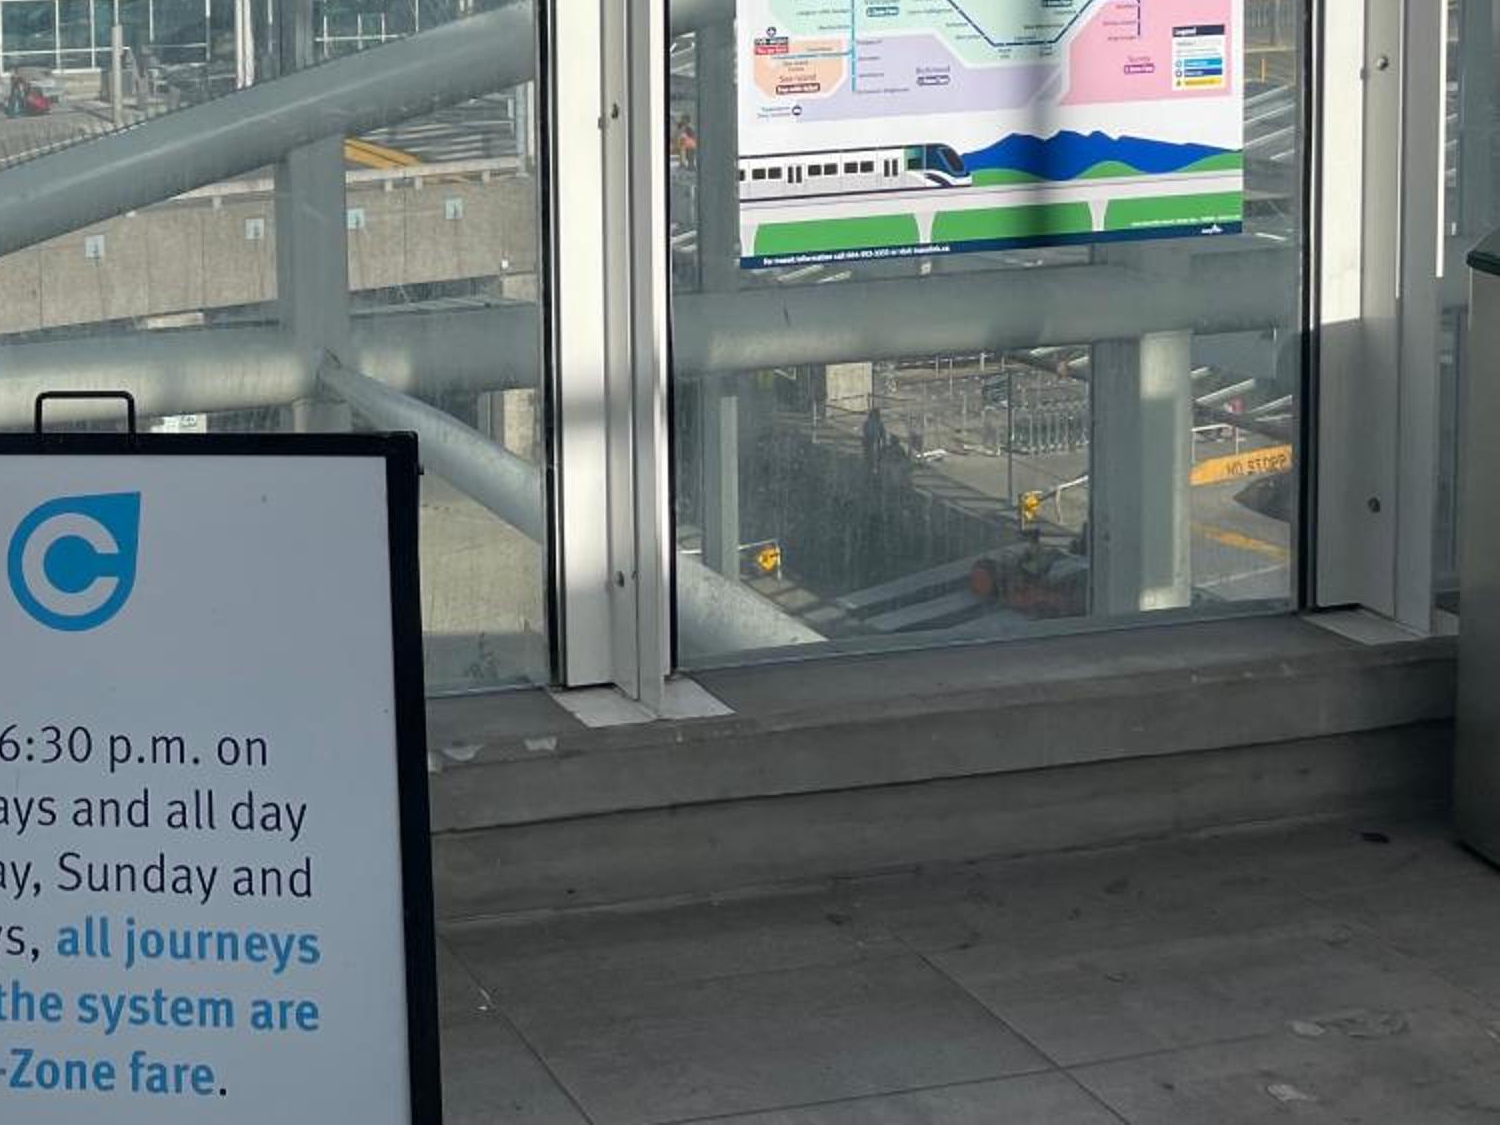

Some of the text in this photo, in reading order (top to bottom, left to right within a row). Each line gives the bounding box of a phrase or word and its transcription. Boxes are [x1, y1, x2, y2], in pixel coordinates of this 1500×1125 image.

[108, 733, 201, 773] p.m.
[217, 734, 268, 766] on
[72, 789, 150, 829] and
[166, 790, 215, 831] all
[231, 791, 307, 840] day
[58, 853, 217, 904] Sunday
[233, 857, 312, 898] and
[57, 917, 112, 958] all
[125, 919, 320, 973] journeys
[77, 989, 234, 1035] system
[250, 998, 319, 1031] are
[129, 1052, 227, 1096] fare.
